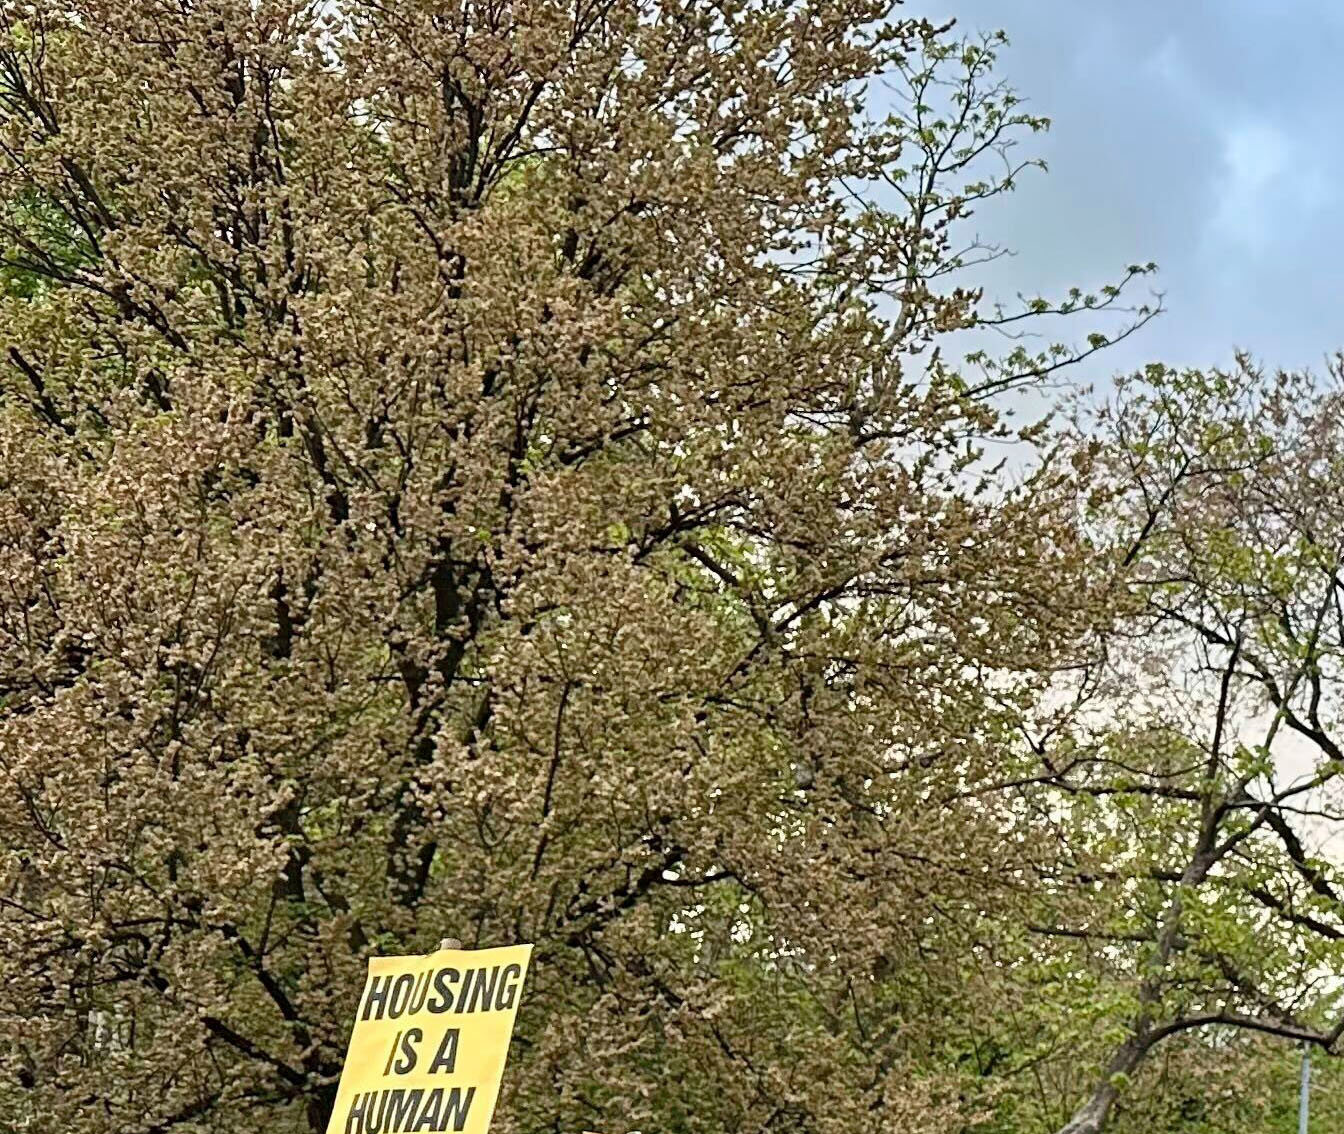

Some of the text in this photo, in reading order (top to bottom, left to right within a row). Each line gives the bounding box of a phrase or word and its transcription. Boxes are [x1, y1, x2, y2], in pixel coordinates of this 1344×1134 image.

[361, 963, 522, 1022] HOUSING
[382, 1027, 461, 1077] IS A
